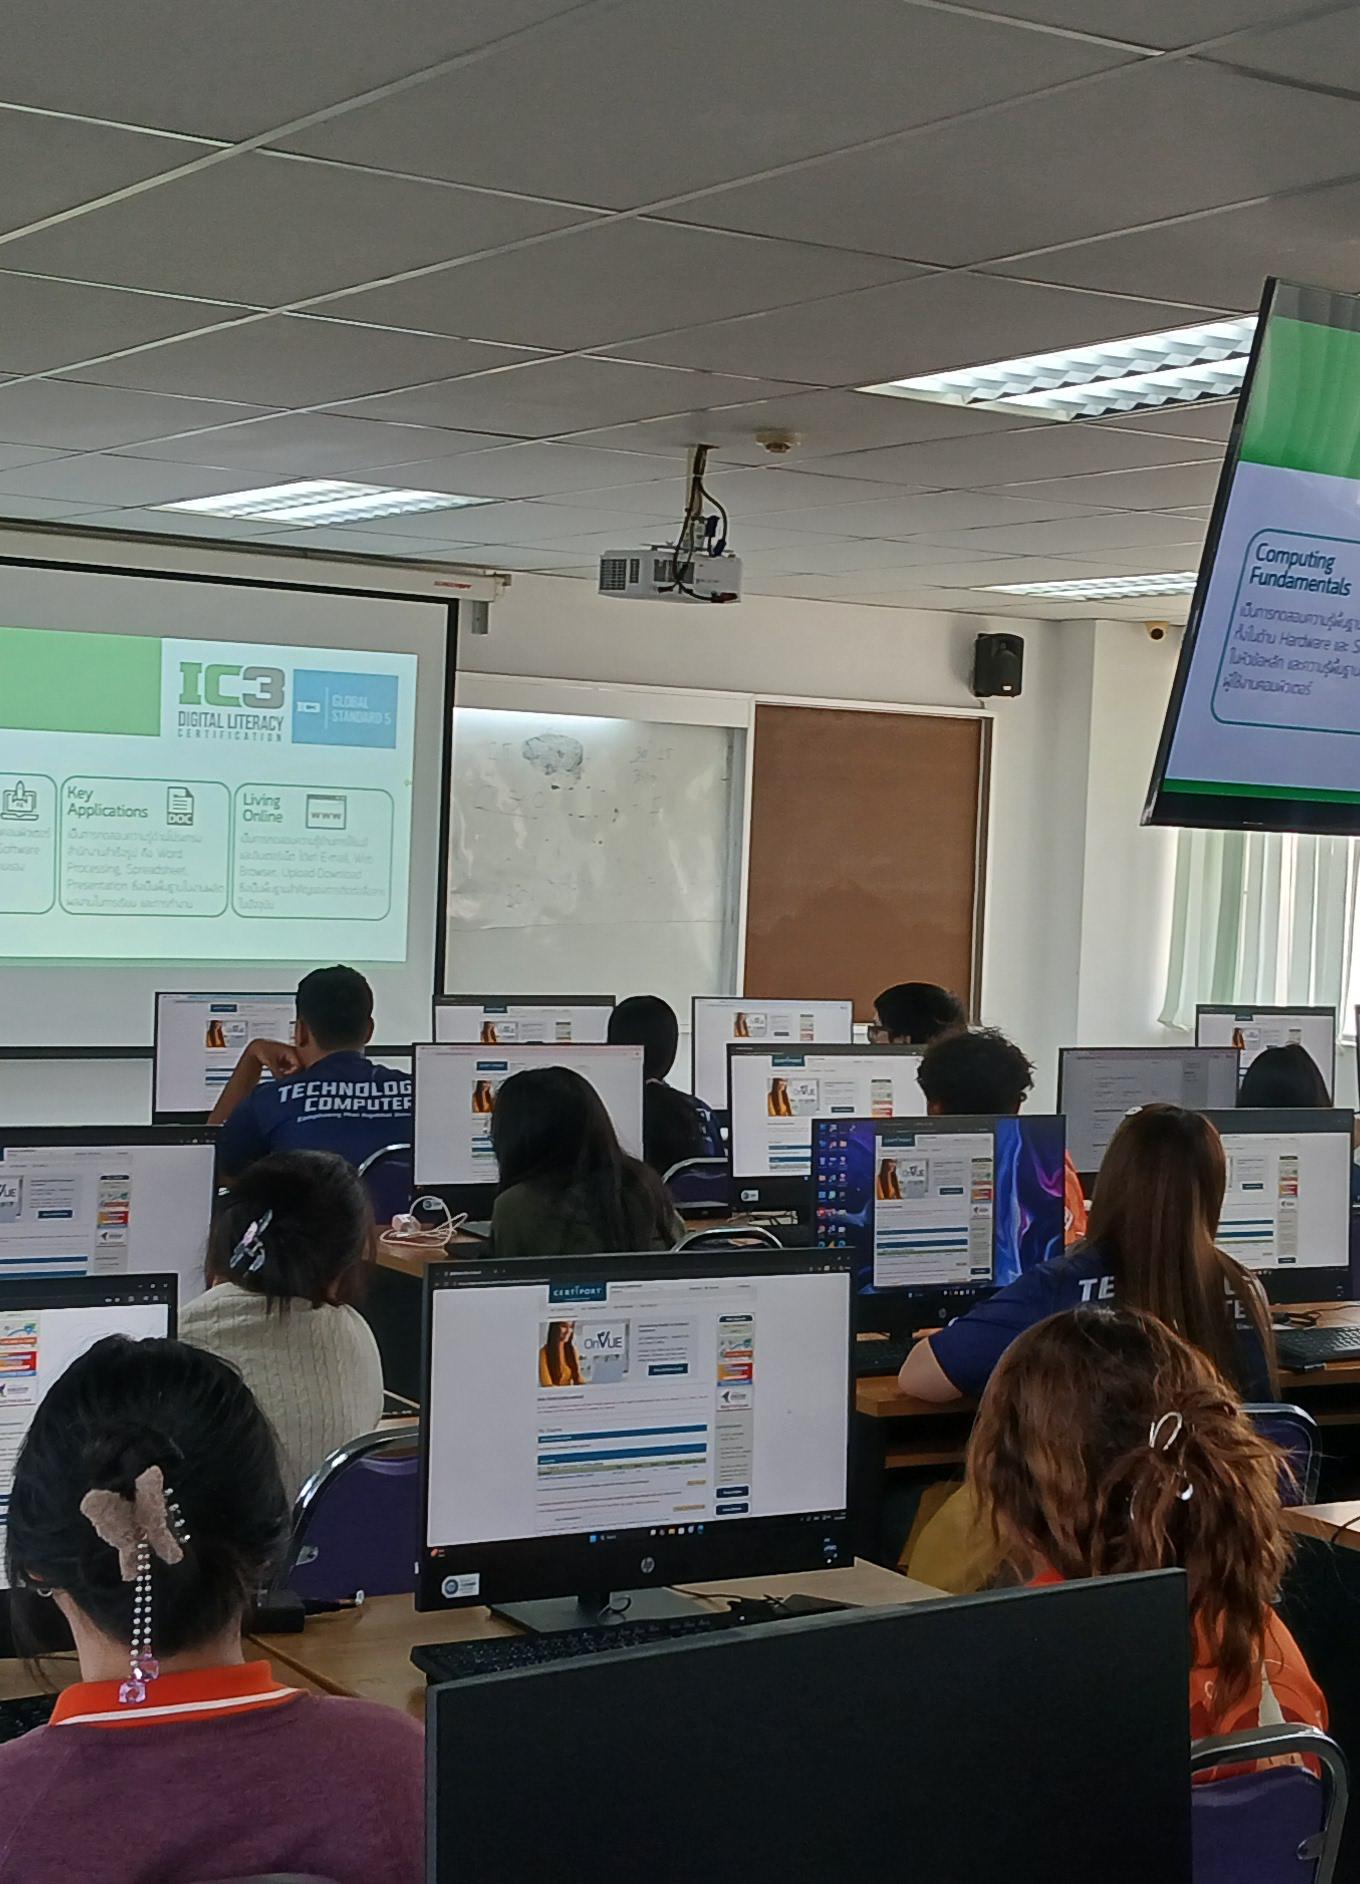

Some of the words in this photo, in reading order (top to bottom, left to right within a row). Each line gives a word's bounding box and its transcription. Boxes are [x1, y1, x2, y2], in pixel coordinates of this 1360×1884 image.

[1255, 543, 1336, 575] Computing
[1249, 566, 1352, 597] Fundamentals
[1280, 631, 1331, 651] Hardware
[178, 661, 286, 710] IC3
[178, 711, 224, 729] DIGITAL
[227, 713, 284, 732] LITERACY
[177, 728, 283, 743] CERTIFICATION
[67, 785, 94, 803] Key
[243, 792, 281, 810] Living
[67, 802, 148, 819] Applications
[168, 813, 192, 824] DOC
[242, 808, 284, 824] Online
[278, 1080, 412, 1103] TECHNOLOG
[553, 1284, 603, 1297] CERTIPORT
[584, 1330, 623, 1350] OnVUE
